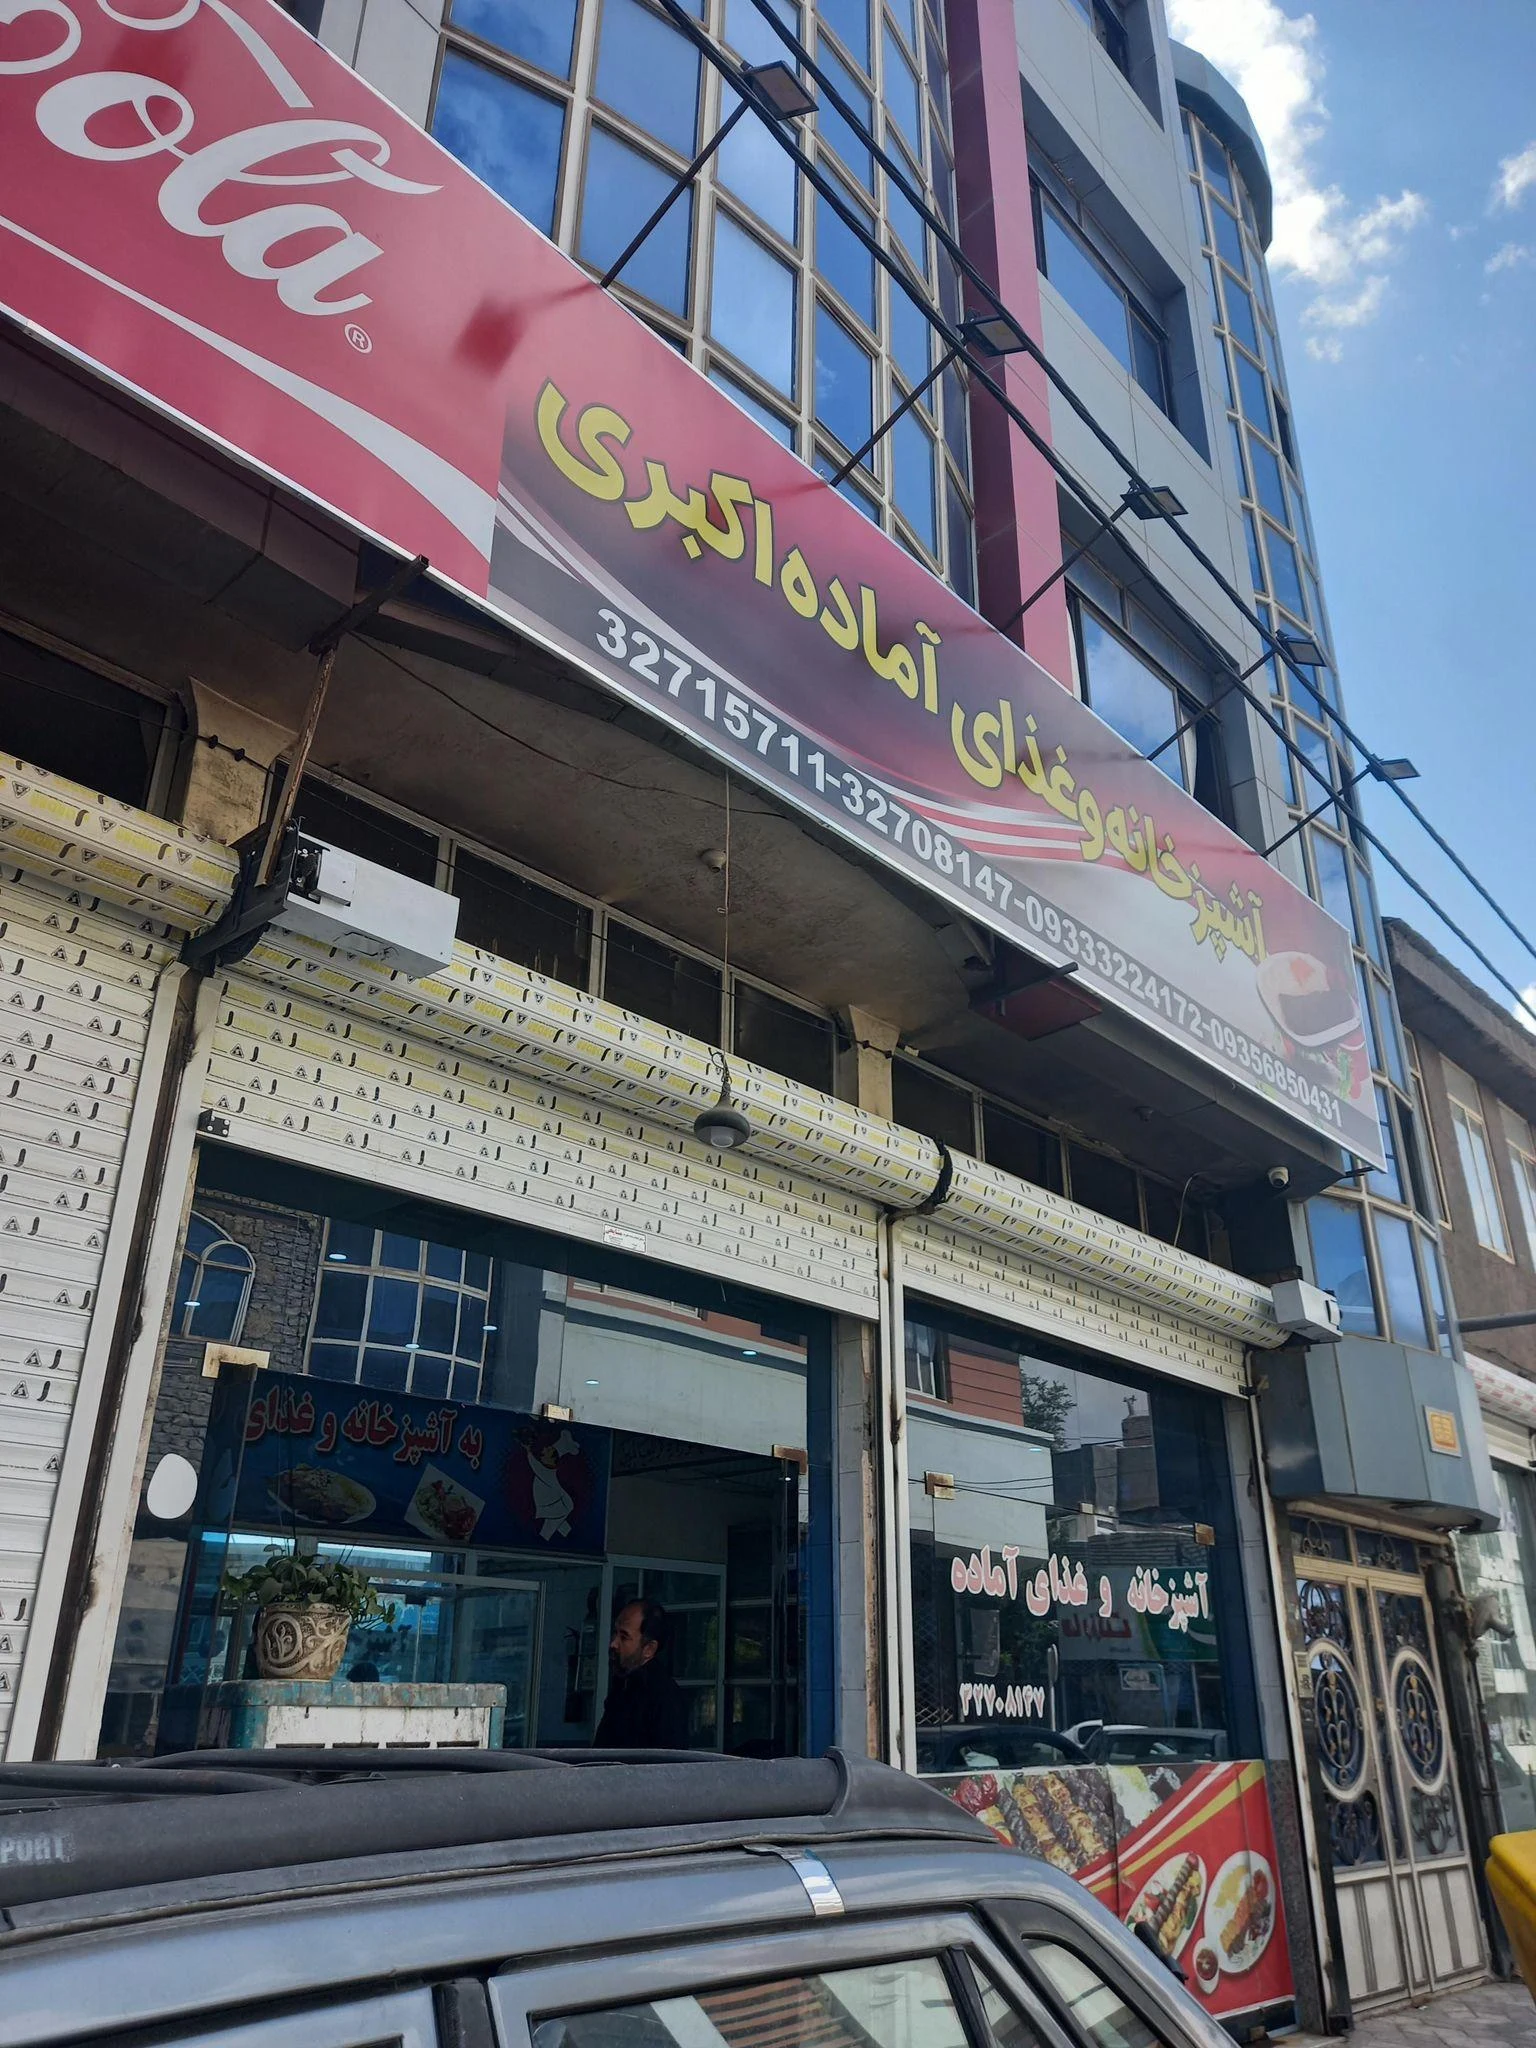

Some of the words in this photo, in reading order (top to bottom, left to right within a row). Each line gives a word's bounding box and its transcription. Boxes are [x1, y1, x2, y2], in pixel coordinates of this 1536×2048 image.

[535, 378, 773, 587] اکبری
[780, 545, 942, 714] آماده
[316, 1412, 336, 1452] و
[341, 1399, 458, 1467] آشپزخانه
[457, 1424, 484, 1469] به
[950, 1544, 1020, 1600] آماده
[1026, 1553, 1088, 1616] غذای
[1098, 1575, 1112, 1618] و
[1127, 1565, 1208, 1634] آشپزخانه
